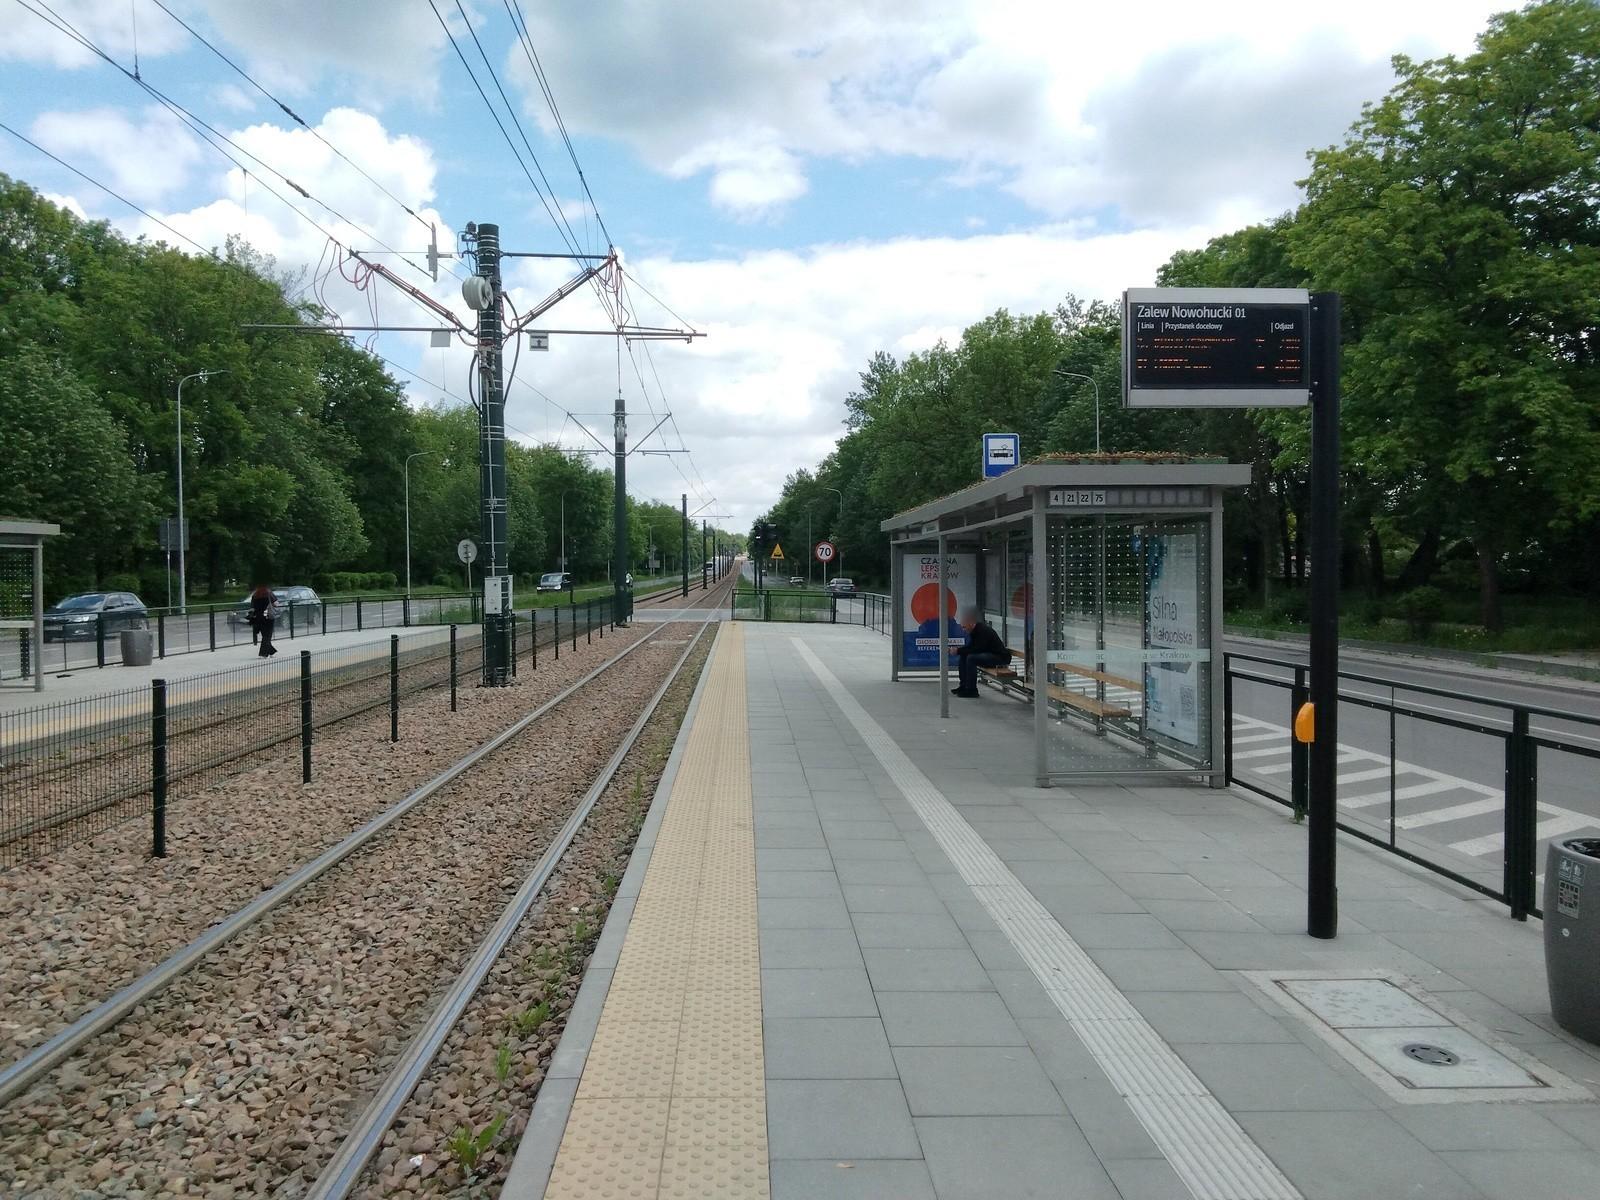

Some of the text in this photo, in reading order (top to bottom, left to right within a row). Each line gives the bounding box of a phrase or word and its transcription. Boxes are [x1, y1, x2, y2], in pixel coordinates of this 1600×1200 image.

[1137, 305, 1246, 319] Zalew Nowohucki 01
[1165, 322, 1223, 331] Przystanek docelowy
[1274, 322, 1294, 331] Odjazd
[1067, 494, 1075, 502] 21
[1080, 494, 1089, 502] 22
[1095, 494, 1104, 502] 75
[819, 547, 832, 557] 70
[1152, 595, 1178, 621] Silna
